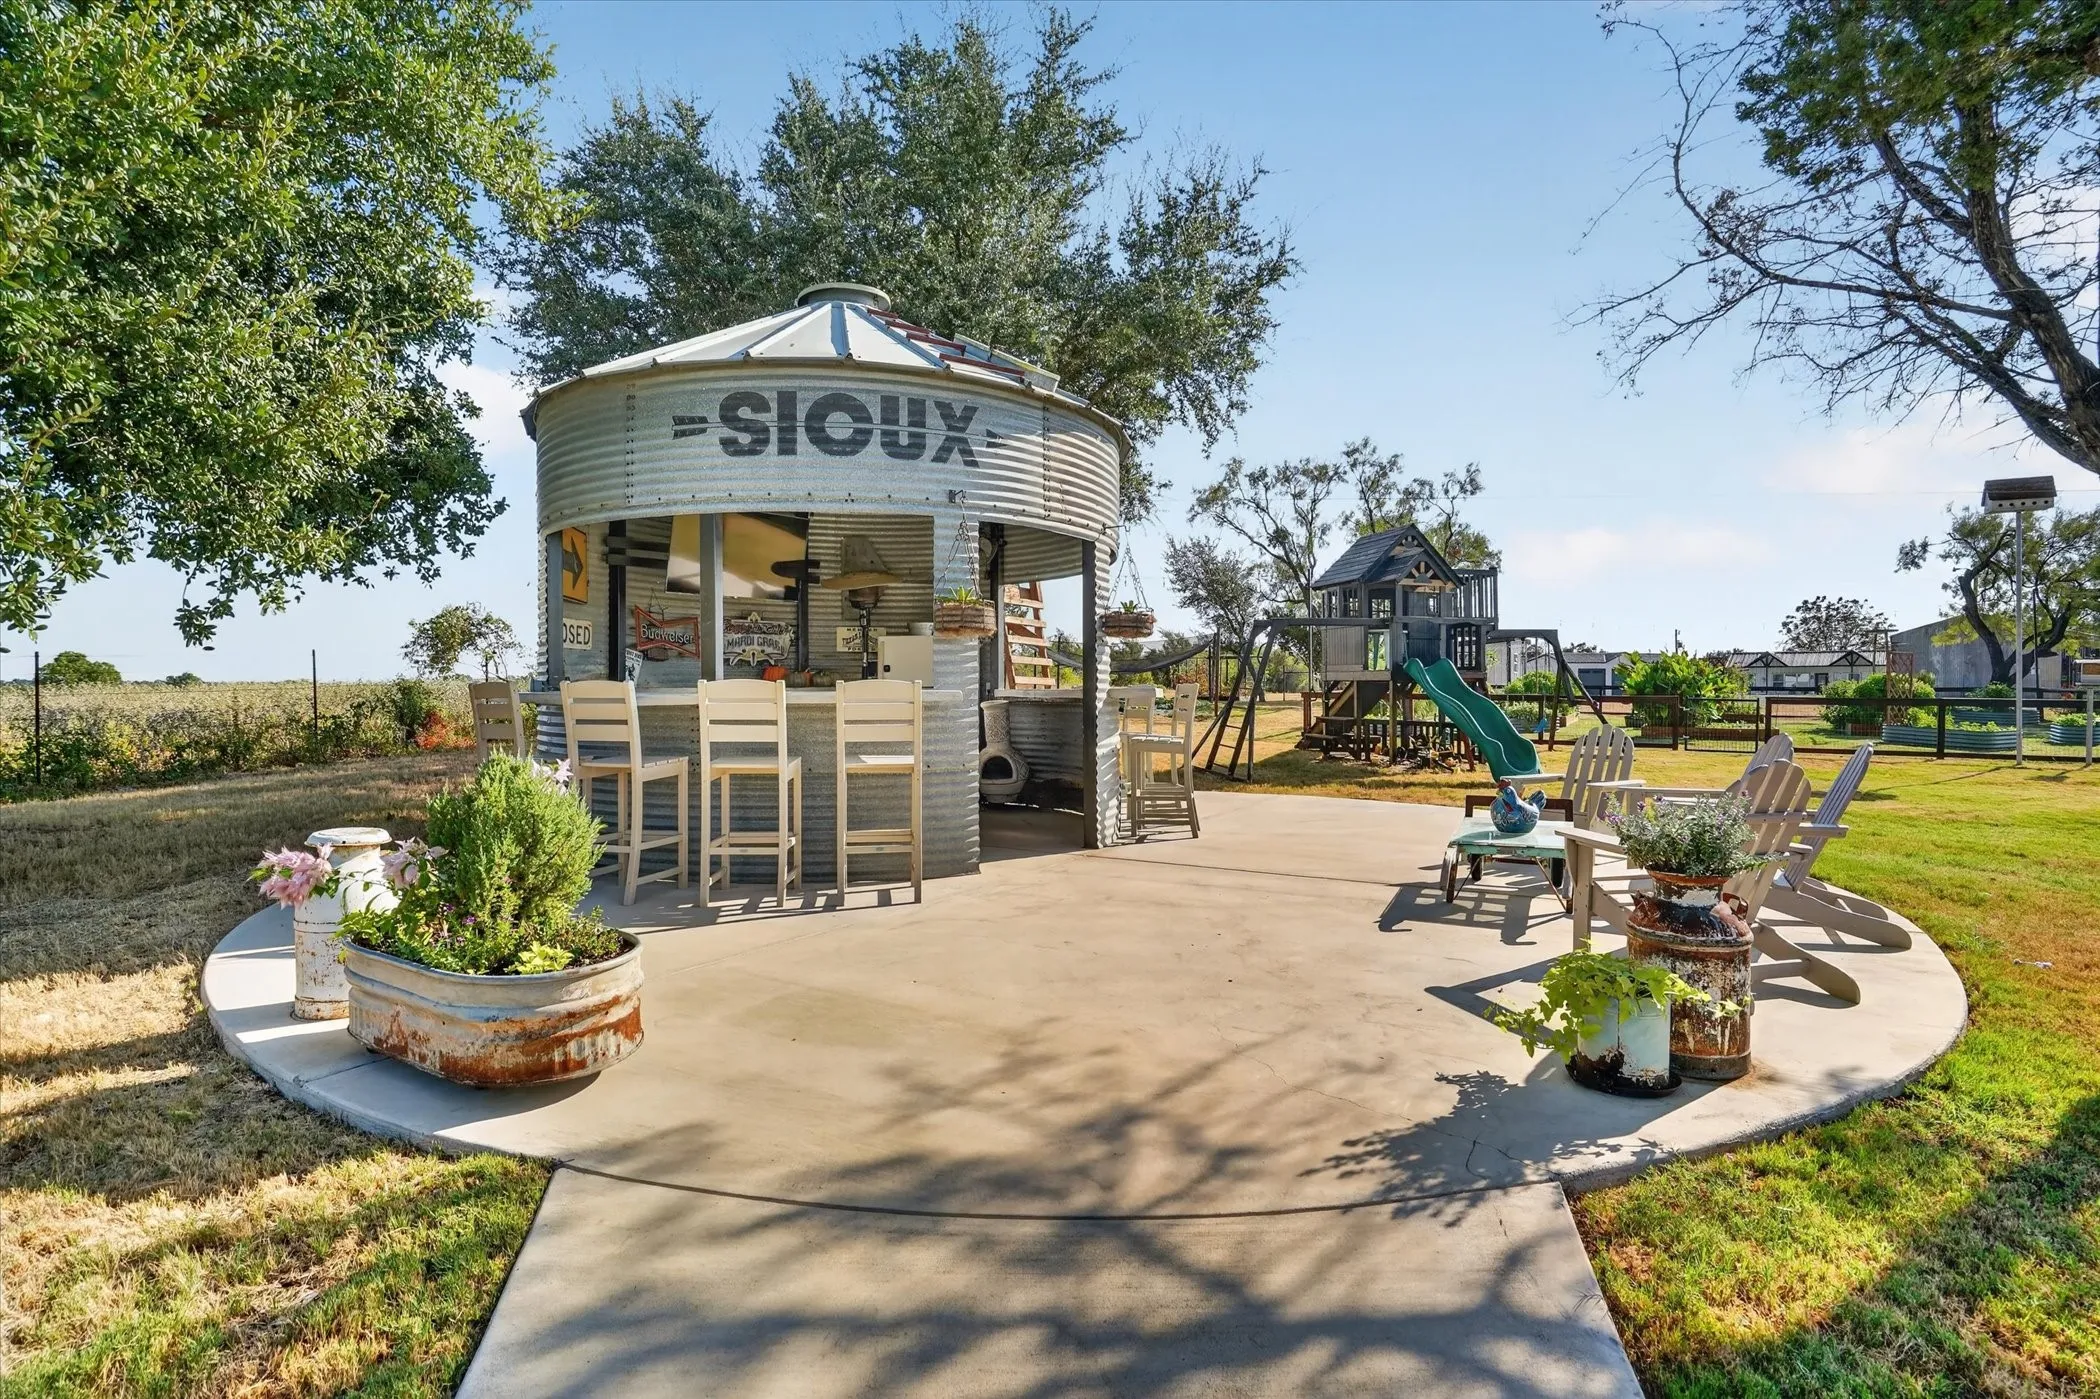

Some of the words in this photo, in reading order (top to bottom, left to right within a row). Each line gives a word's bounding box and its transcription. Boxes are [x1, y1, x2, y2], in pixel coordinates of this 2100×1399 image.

[718, 390, 980, 469] SIOUX
[641, 623, 695, 645] Budweiser
[727, 636, 755, 650] MARDI
[757, 636, 780, 651] GRAS
